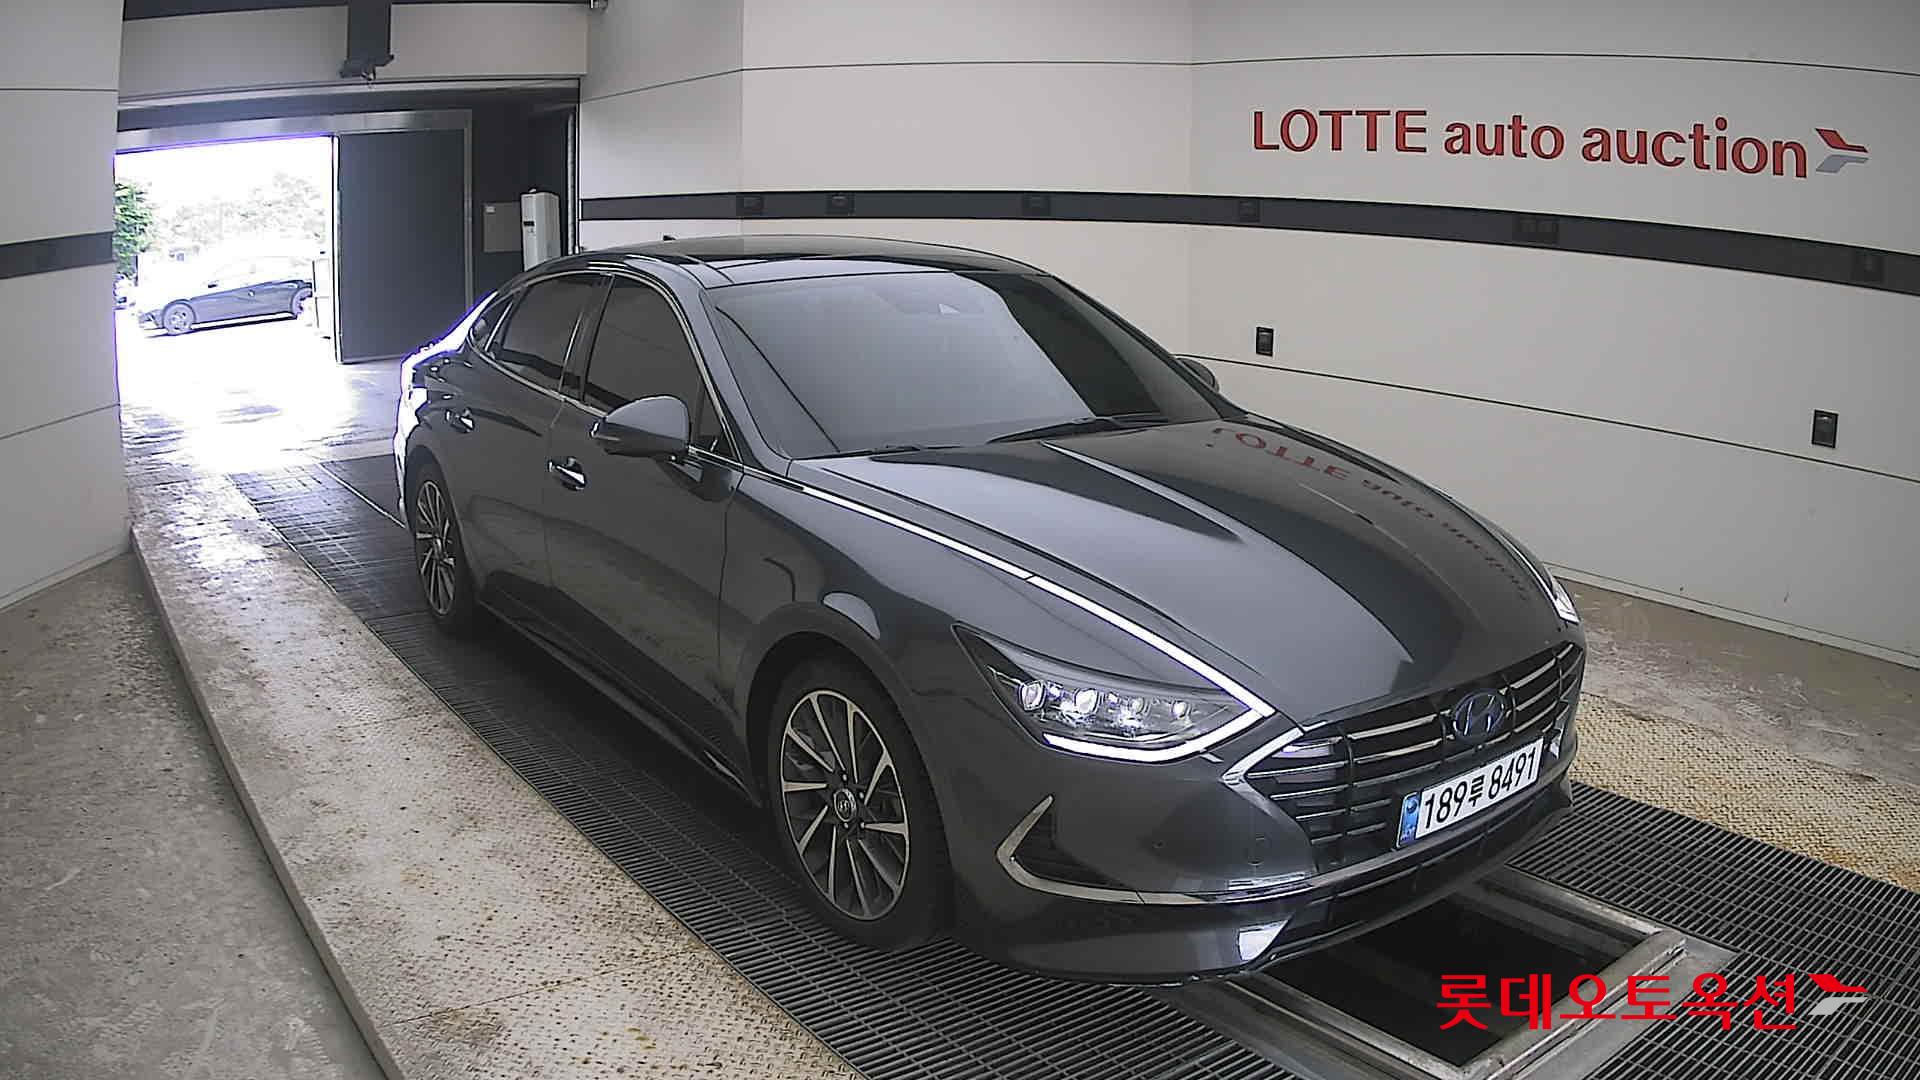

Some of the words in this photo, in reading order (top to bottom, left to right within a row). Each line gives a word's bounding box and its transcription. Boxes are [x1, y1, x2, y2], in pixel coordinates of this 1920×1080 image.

[1252, 110, 1427, 154] LOTTE
[1443, 115, 1566, 160] auto
[1581, 116, 1808, 178] auction
[1425, 774, 1485, 829] 189루
[1488, 747, 1536, 800] 8491
